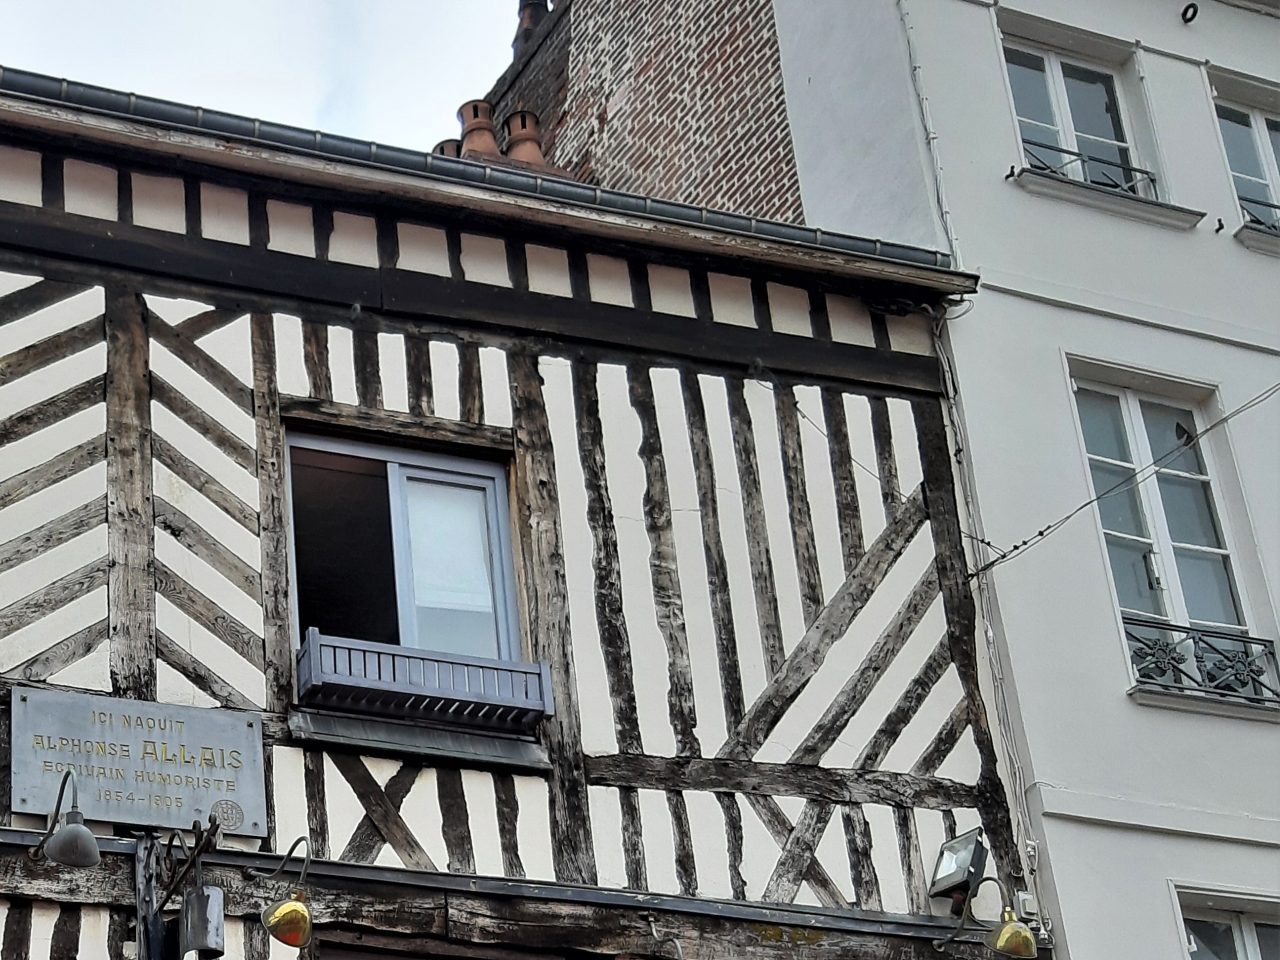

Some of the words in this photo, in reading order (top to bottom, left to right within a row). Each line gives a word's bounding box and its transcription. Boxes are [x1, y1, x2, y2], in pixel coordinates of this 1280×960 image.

[92, 710, 113, 726] ICI
[122, 714, 185, 732] NAQUIT
[32, 734, 131, 759] ALPHONSE
[140, 740, 244, 769] ALLAIS
[134, 770, 237, 793] HUMORISTE
